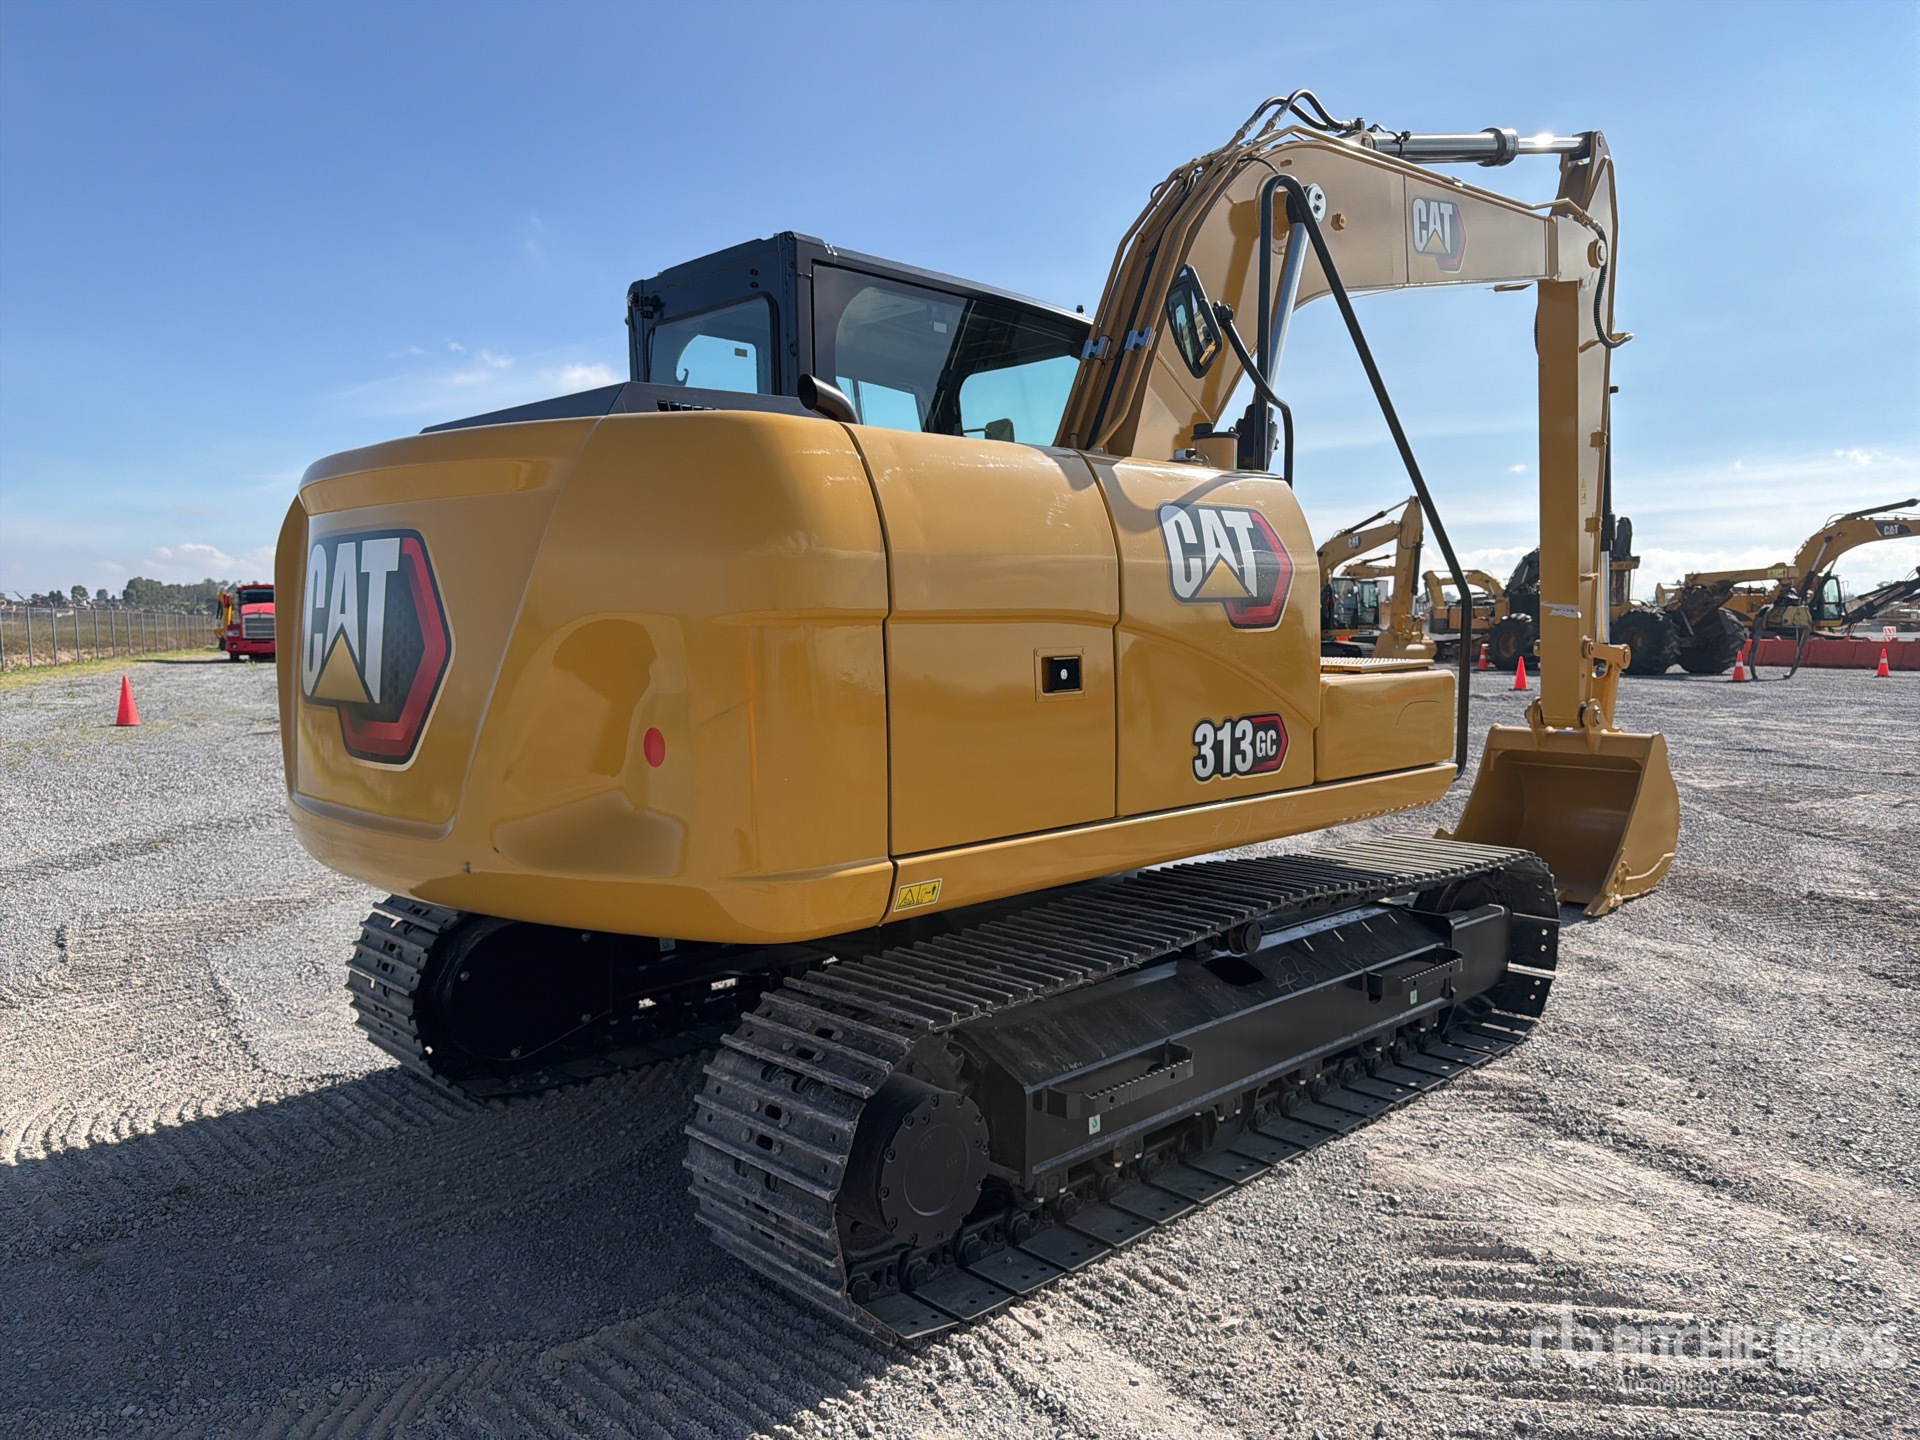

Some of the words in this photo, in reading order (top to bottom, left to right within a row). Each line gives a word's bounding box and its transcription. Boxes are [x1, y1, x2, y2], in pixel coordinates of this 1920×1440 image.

[1413, 198, 1453, 254] CAT
[1160, 505, 1258, 598] CAT
[1347, 535, 1360, 549] CAT
[1883, 524, 1899, 536] CAT
[302, 538, 401, 704] CAT
[1194, 719, 1254, 778] 313
[1256, 729, 1277, 758] GC
